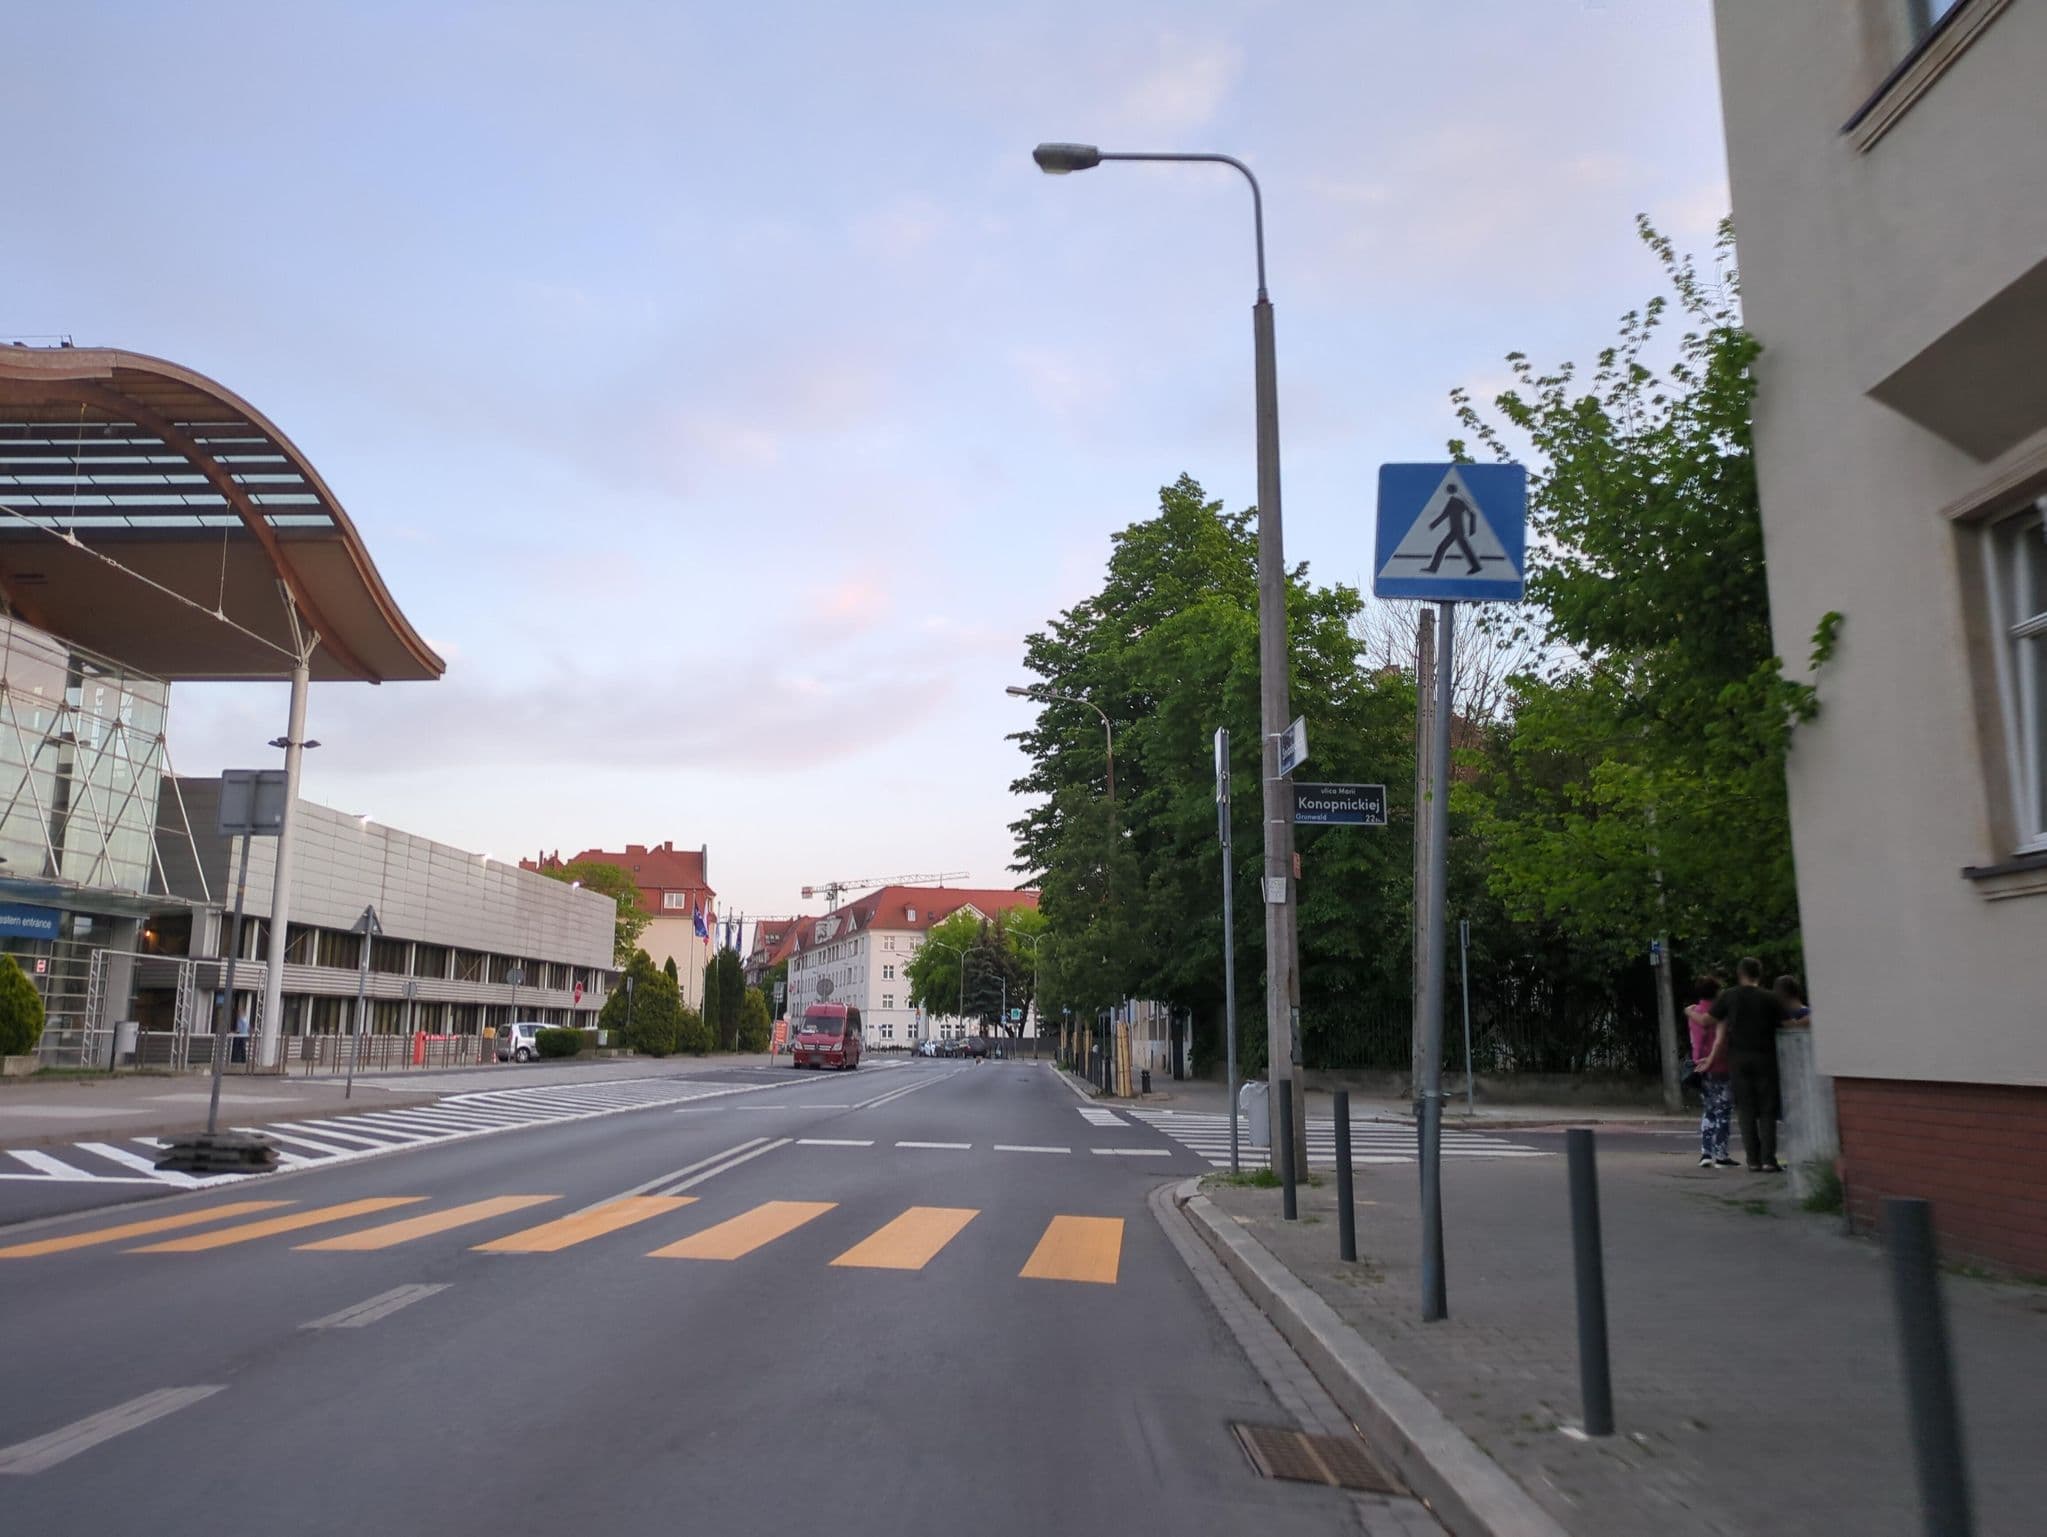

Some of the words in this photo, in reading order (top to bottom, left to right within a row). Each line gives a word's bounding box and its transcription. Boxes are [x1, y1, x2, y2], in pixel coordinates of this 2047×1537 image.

[1298, 796, 1380, 813] Konopnickiej
[1295, 813, 1327, 821] Grunwald
[22, 917, 52, 929] entrance
